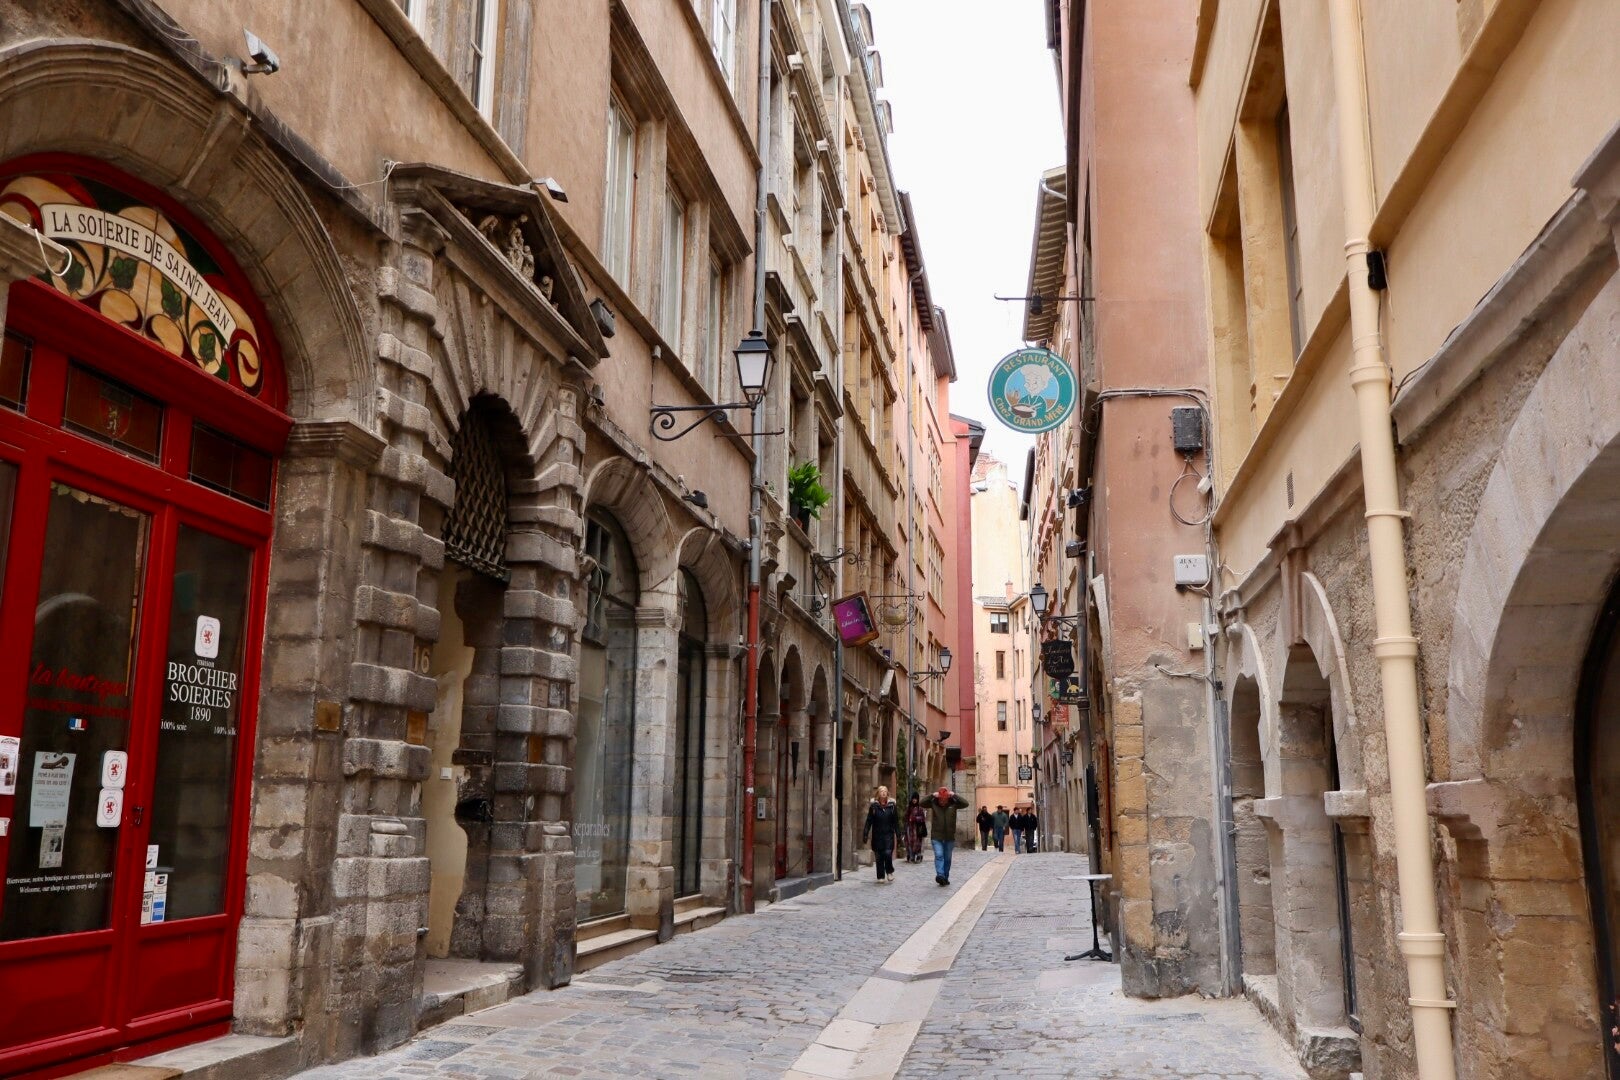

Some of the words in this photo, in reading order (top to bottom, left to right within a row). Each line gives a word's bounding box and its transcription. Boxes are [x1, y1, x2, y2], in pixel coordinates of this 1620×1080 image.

[52, 211, 72, 233] LA
[78, 213, 140, 250] SOIERIE
[144, 236, 163, 262] DE
[165, 252, 203, 297] SAINT
[203, 291, 230, 331] JEAN
[1003, 354, 1066, 377] RESTAURANT
[414, 645, 430, 674] 16
[167, 661, 237, 691] BROCHIER
[170, 682, 231, 709] SOIERIES
[160, 720, 175, 731] 100%
[176, 722, 187, 731] soie
[190, 706, 211, 722] 1890
